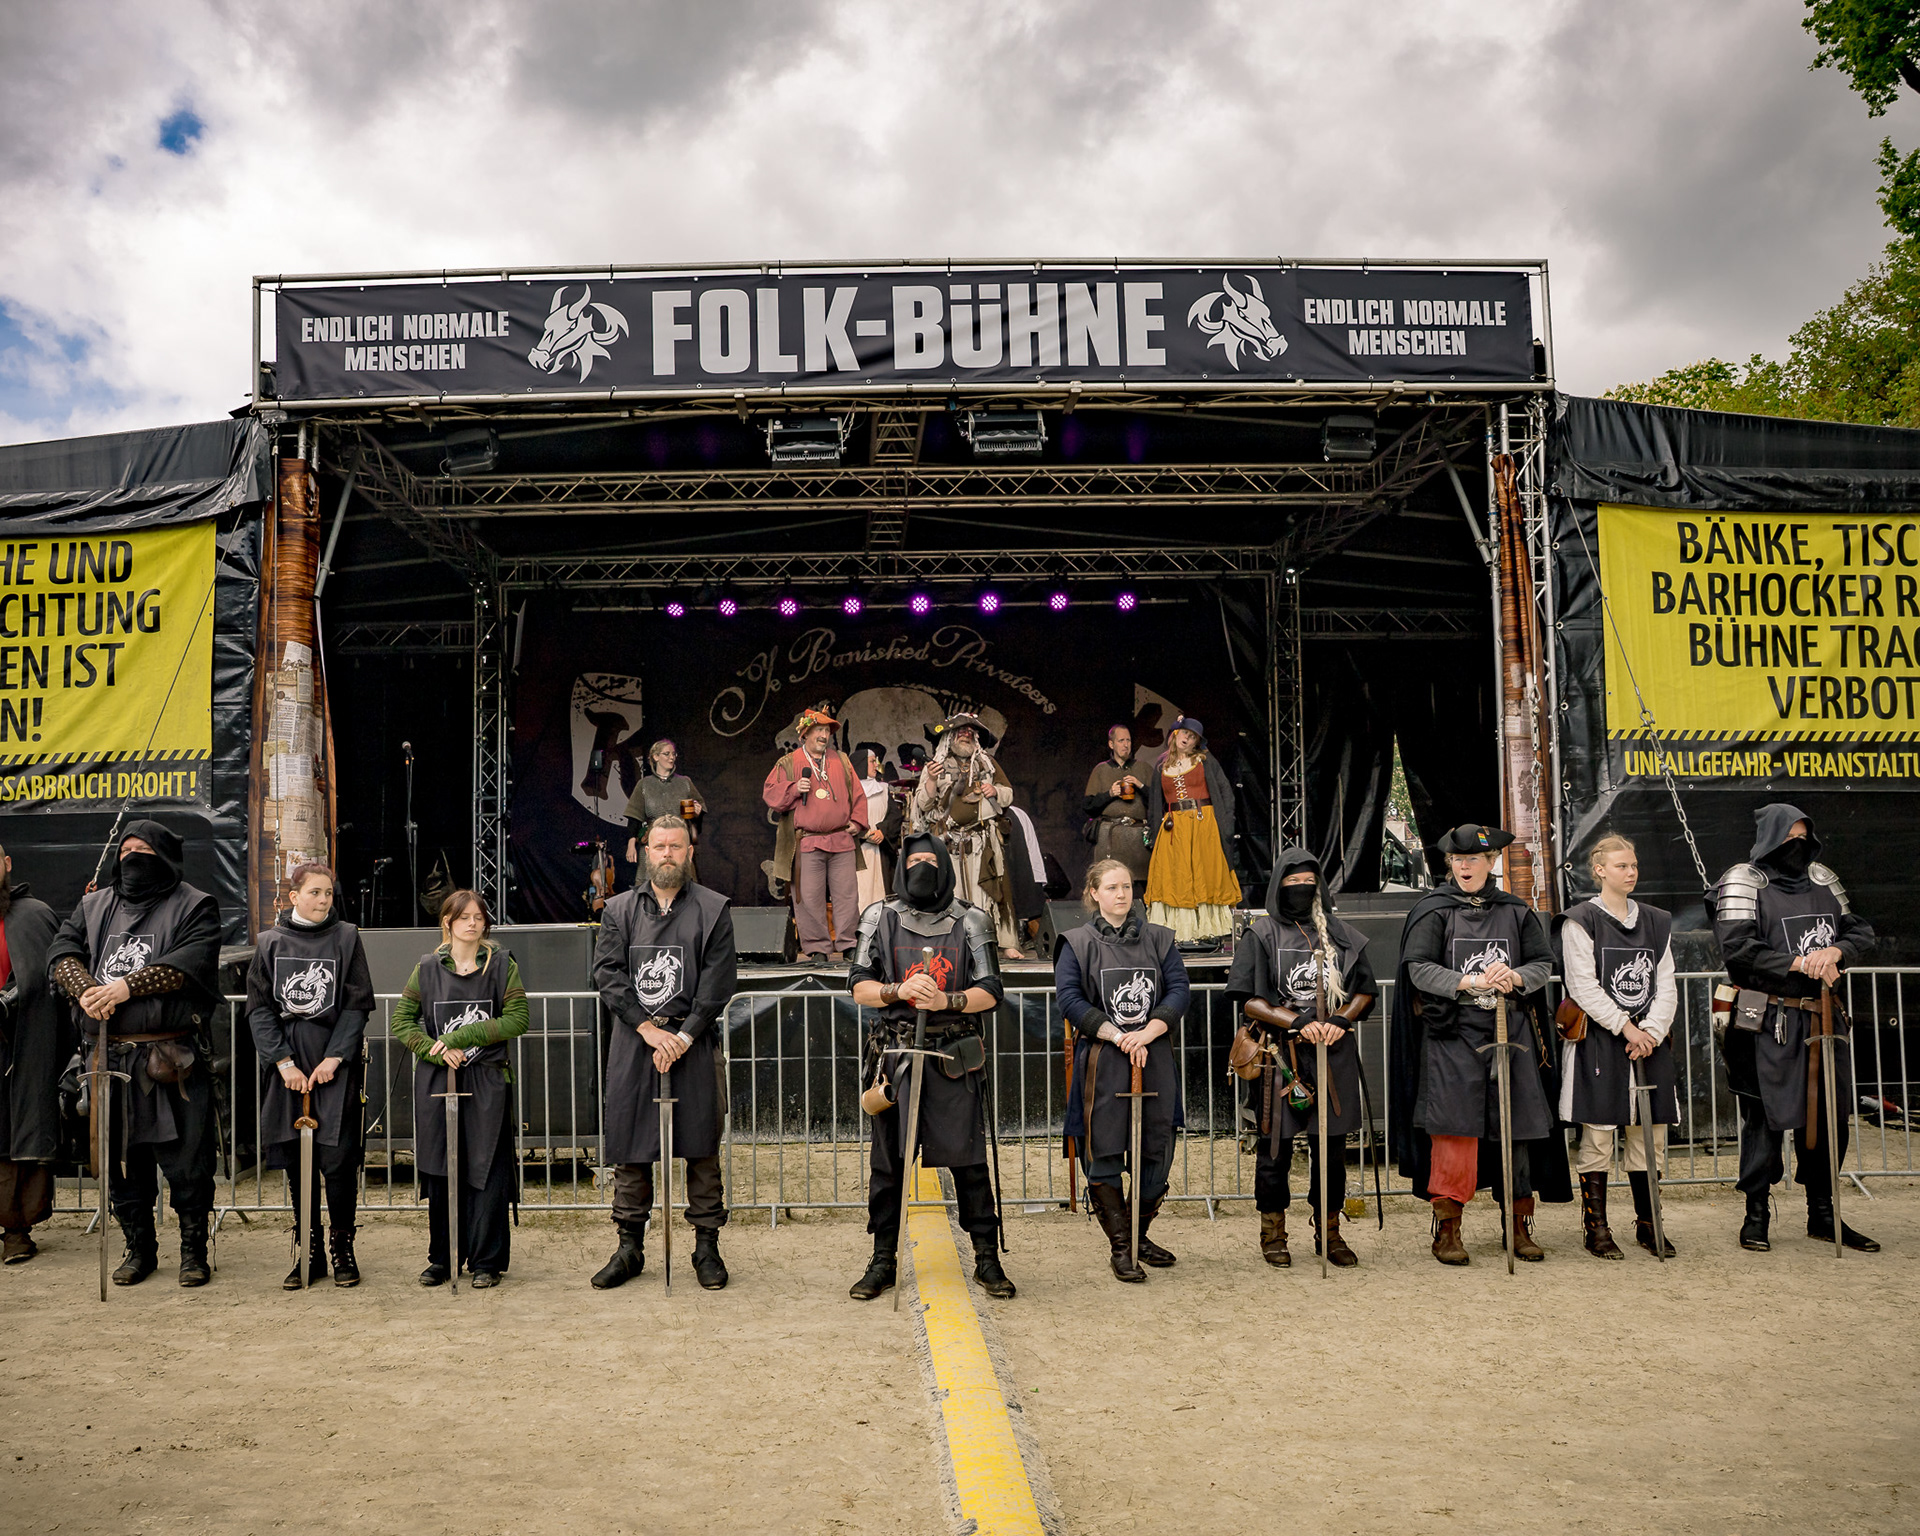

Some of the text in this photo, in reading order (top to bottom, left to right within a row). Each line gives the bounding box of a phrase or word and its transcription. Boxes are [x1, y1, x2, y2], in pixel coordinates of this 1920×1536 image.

[301, 310, 510, 343] ENDLICH NORMALE
[651, 281, 1168, 376] FOLK-BÜHNE
[1304, 298, 1507, 326] ENDLICH NORMALE
[344, 342, 466, 372] MENSCHEN
[1348, 329, 1467, 356] MENSCHEN
[48, 540, 133, 585] UND
[1677, 516, 1919, 572] BÄNKE, TISC
[0, 588, 161, 639] CHTUNG
[1651, 571, 1920, 618] BARHOCKER R
[1689, 616, 1822, 668] BÜHNE
[0, 642, 125, 690] EN IST
[788, 627, 931, 683] Banished
[932, 624, 1057, 716] Privateers
[0, 697, 44, 743] N!
[1767, 675, 1920, 720] VERBOT
[0, 770, 197, 802] SABBRUCH DROHT!
[287, 989, 313, 1001] MPS
[639, 979, 663, 990] MPS
[1117, 1001, 1142, 1013] MPS
[1617, 980, 1642, 992] MPS
